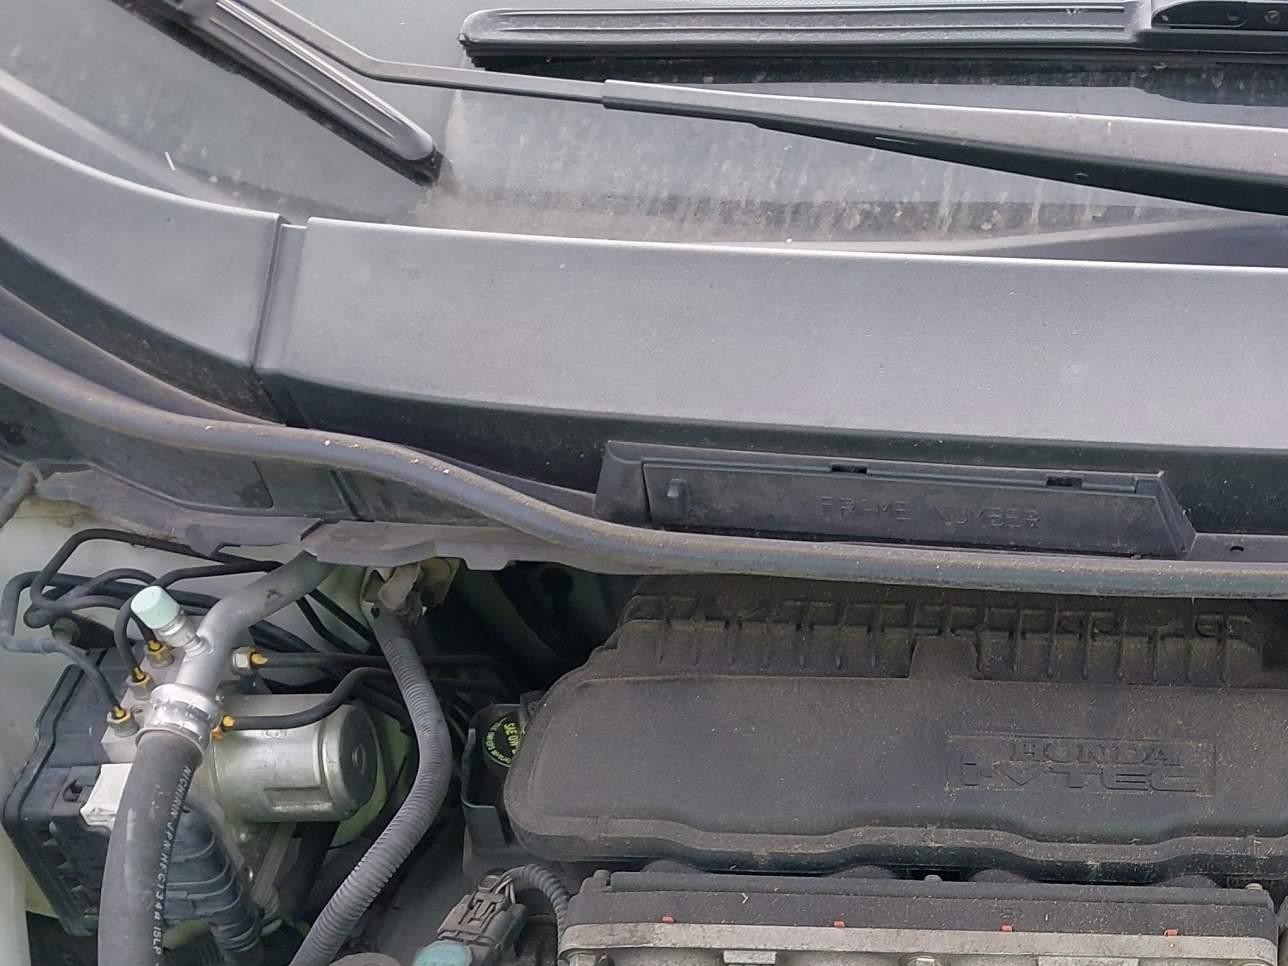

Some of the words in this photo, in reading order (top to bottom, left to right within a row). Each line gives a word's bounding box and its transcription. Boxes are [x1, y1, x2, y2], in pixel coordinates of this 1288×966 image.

[820, 496, 912, 521] FRAME
[934, 504, 1041, 528] NUMBER
[1010, 743, 1183, 767] HONDA
[170, 765, 192, 817] NICHIRIN
[162, 821, 174, 850] JPN
